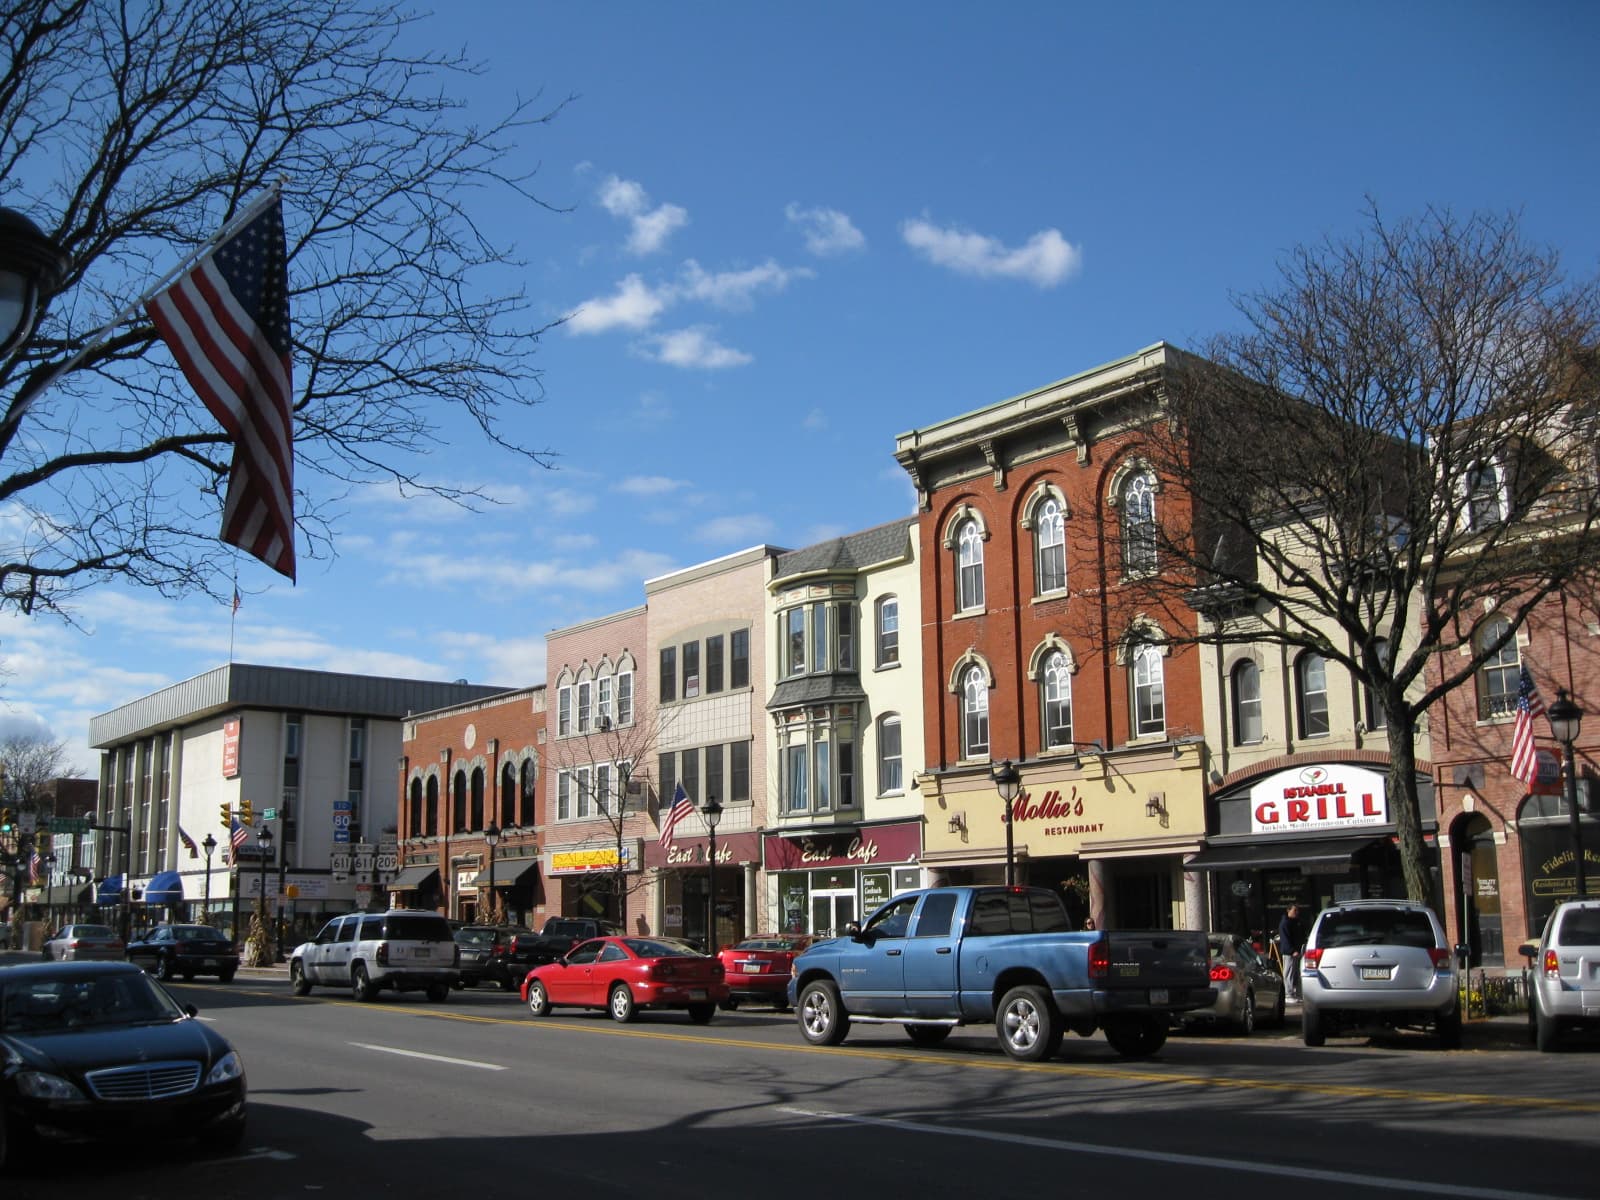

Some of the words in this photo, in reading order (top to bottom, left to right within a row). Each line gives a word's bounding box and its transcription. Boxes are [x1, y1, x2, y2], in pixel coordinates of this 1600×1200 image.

[1284, 783, 1347, 799] ISTANBUL
[1001, 785, 1084, 823] Mollie's
[1255, 793, 1382, 824] GRILL
[335, 815, 350, 827] 80
[1044, 823, 1104, 836] RESTAURANT
[667, 845, 694, 864] East
[801, 841, 832, 862] East
[847, 837, 878, 863] Cafe
[334, 859, 349, 868] 611
[355, 858, 373, 868] 611
[378, 858, 397, 868] 209
[1542, 850, 1575, 874] Fidelit
